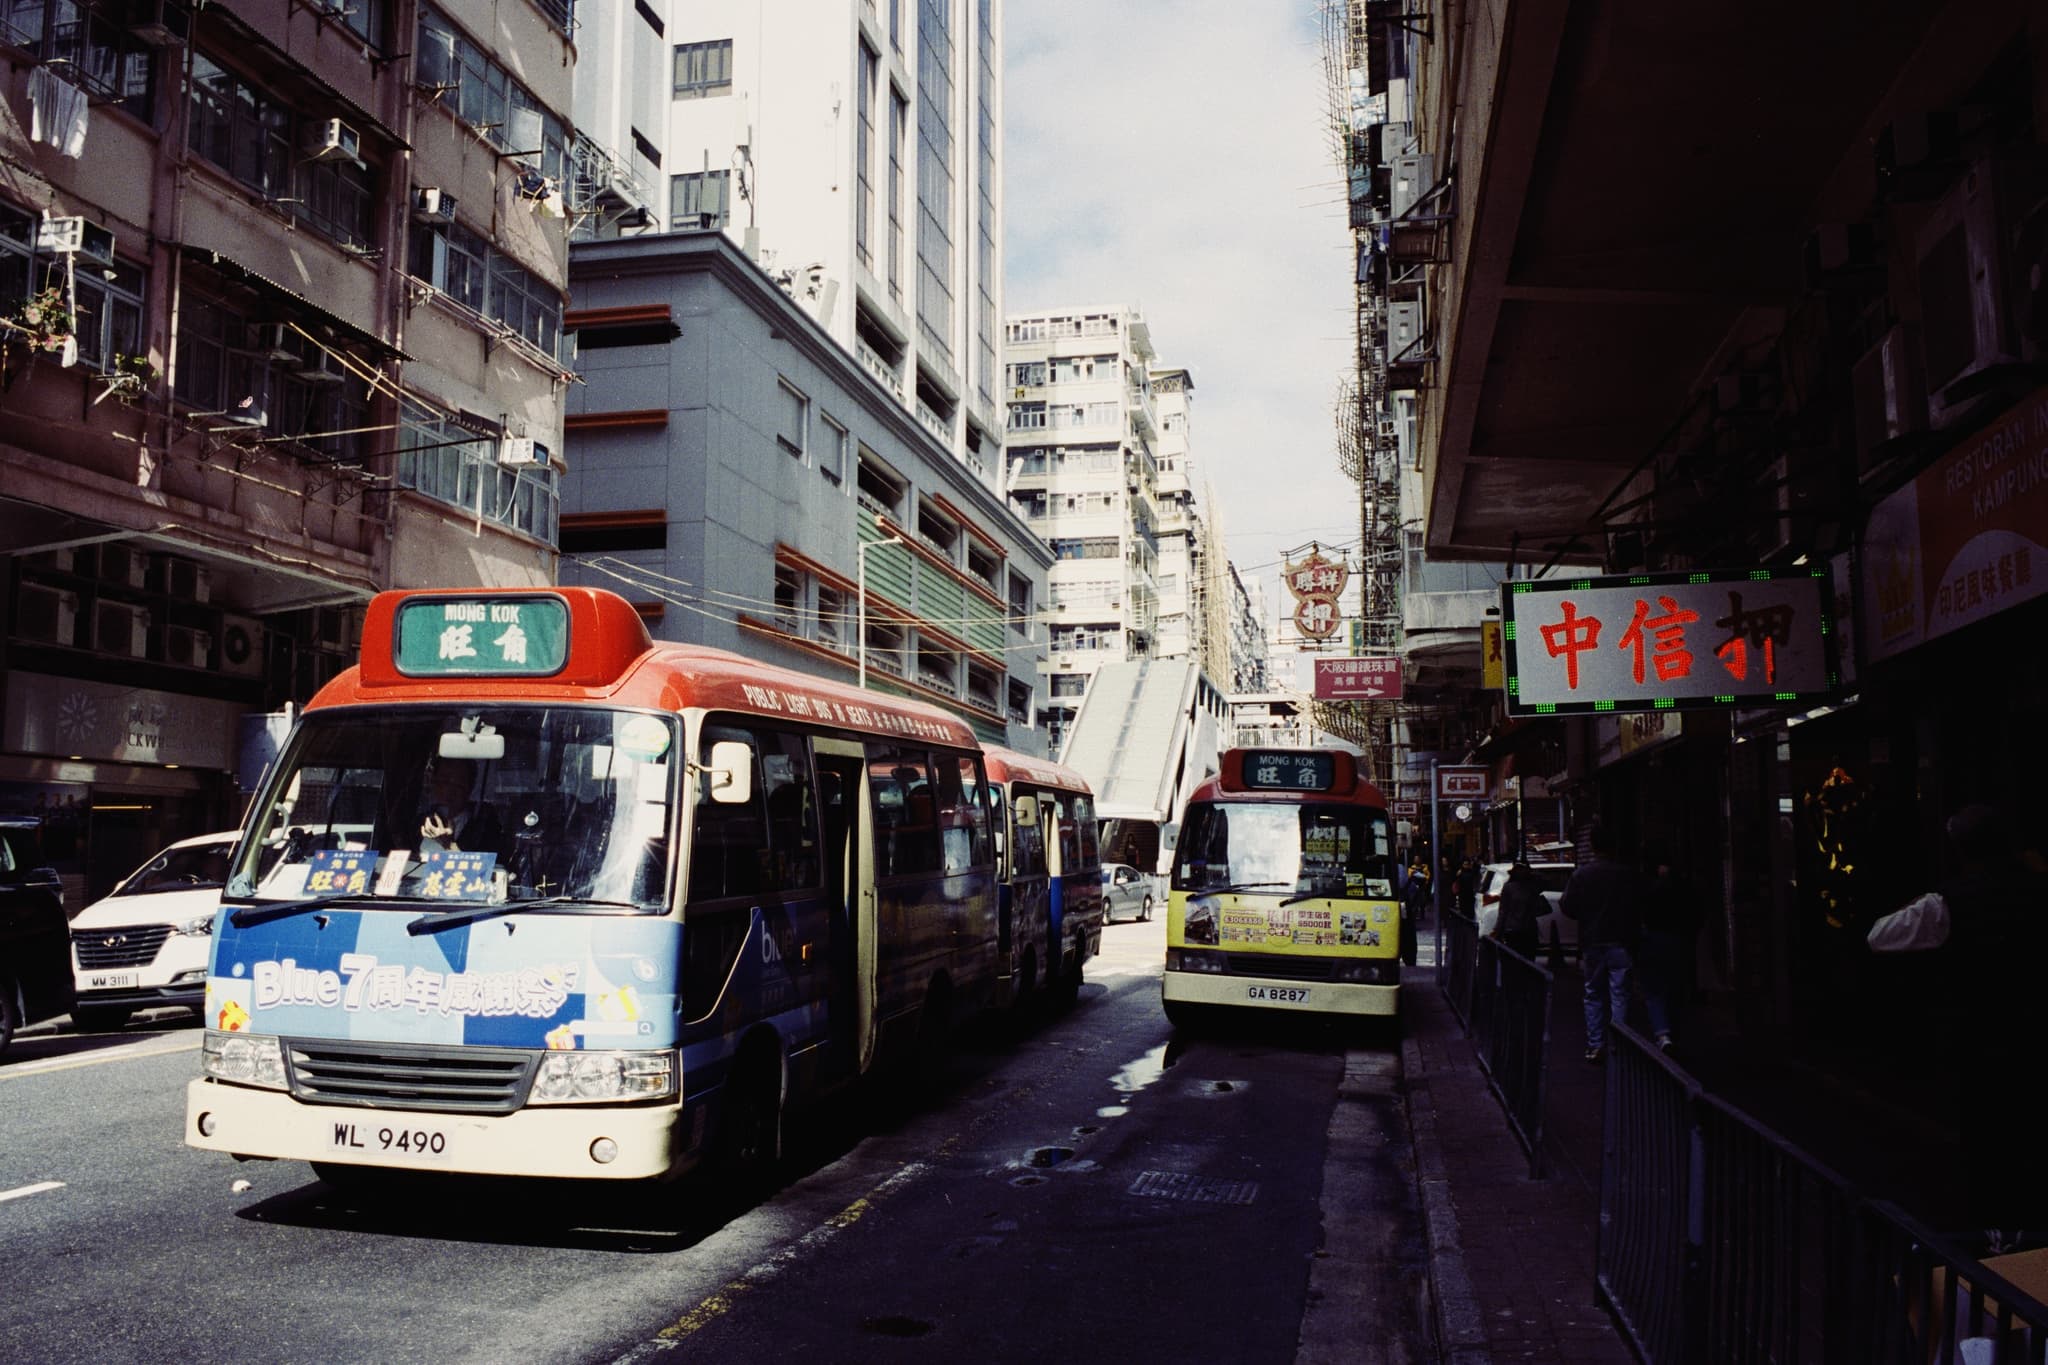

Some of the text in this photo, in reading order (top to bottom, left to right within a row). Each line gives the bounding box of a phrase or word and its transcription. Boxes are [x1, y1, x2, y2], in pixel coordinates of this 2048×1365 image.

[1945, 417, 2025, 496] RESTORAN
[444, 604, 520, 623] MONG KOK
[1302, 600, 1332, 632] 押
[1538, 589, 1795, 690] 中信押
[741, 683, 782, 711] PUBLIC
[783, 693, 813, 716] LIGHT
[812, 698, 833, 720] BUS
[845, 705, 873, 727] SEATS
[1258, 755, 1316, 767] MONG KOK
[1256, 766, 1318, 788] 旺角
[110, 975, 129, 986] 3111
[1248, 987, 1307, 1002] GA 8287
[334, 1123, 446, 1154] WL 9490
